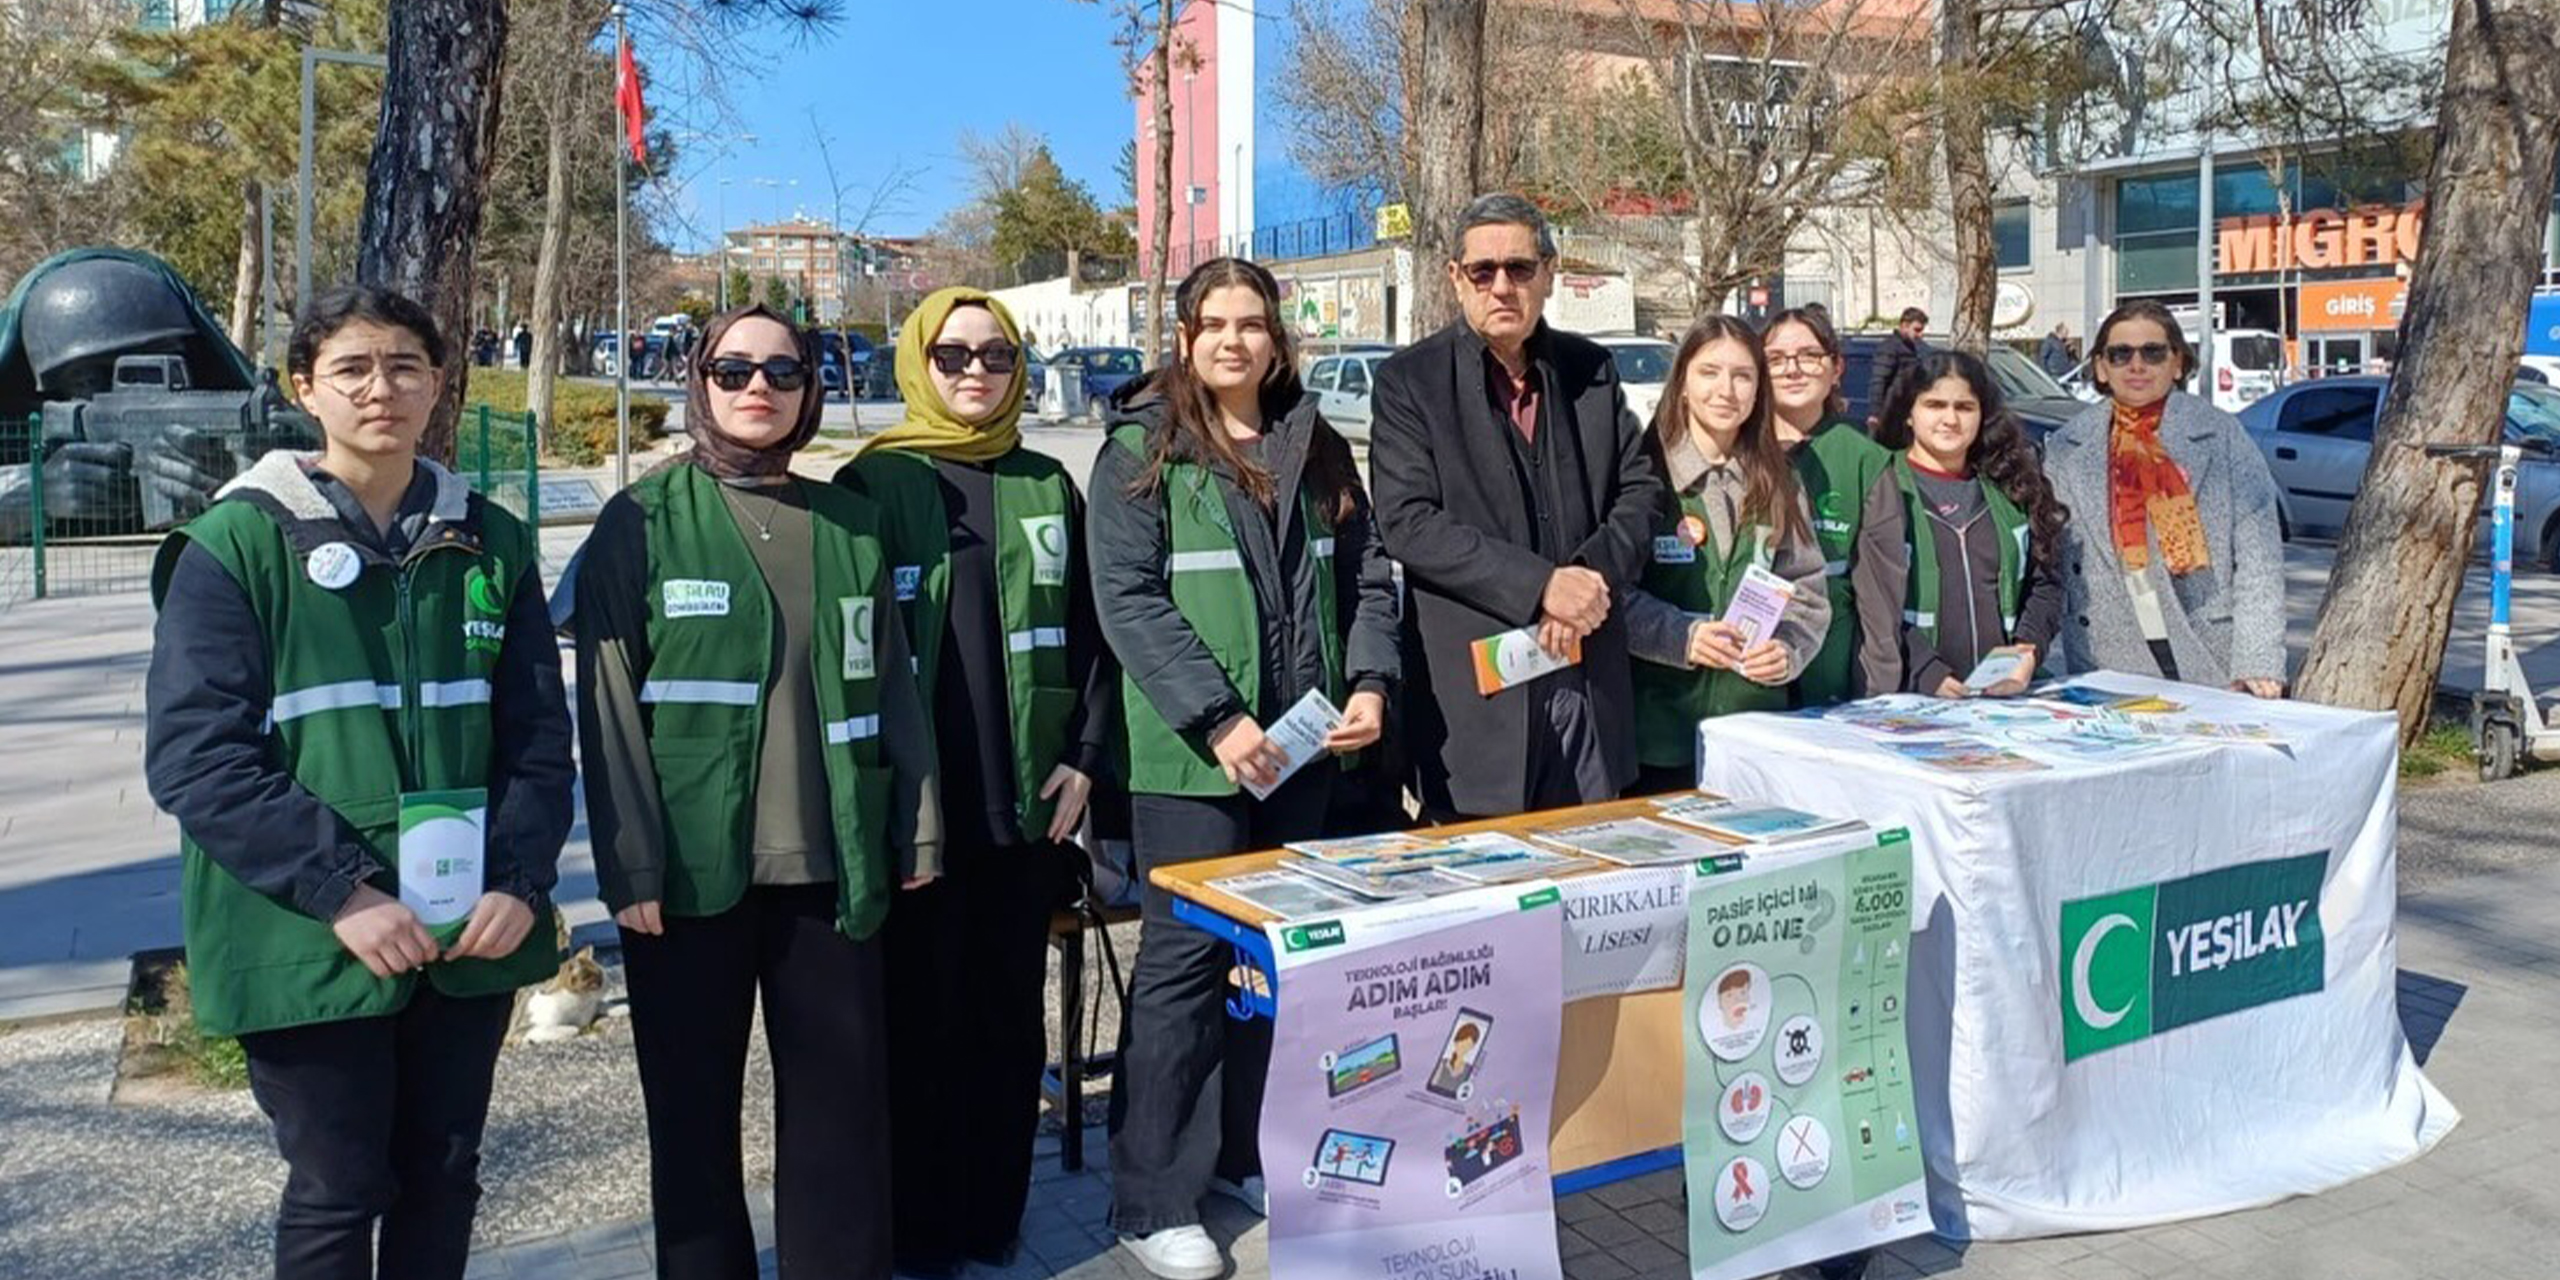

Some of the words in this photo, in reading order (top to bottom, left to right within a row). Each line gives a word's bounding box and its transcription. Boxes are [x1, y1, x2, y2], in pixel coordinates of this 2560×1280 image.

[2220, 202, 2424, 273] MIGRO
[2325, 294, 2375, 317] GİRİŞ
[1562, 885, 1684, 921] KIRIKKALE
[1708, 897, 1753, 924] PASİF
[1758, 889, 1795, 916] İÇİCİ
[1585, 923, 1653, 954] LİSESİ
[1713, 925, 1731, 948] O
[1737, 921, 1768, 946] DA
[1773, 918, 1804, 940] NE
[2166, 900, 2308, 977] YEŞİLAY
[1345, 958, 1419, 983] TEKNOLOJİ
[1420, 945, 1495, 971] BAĞIMLILIĞI
[1347, 976, 1418, 1012] ADIM
[1424, 963, 1491, 997] ADIM
